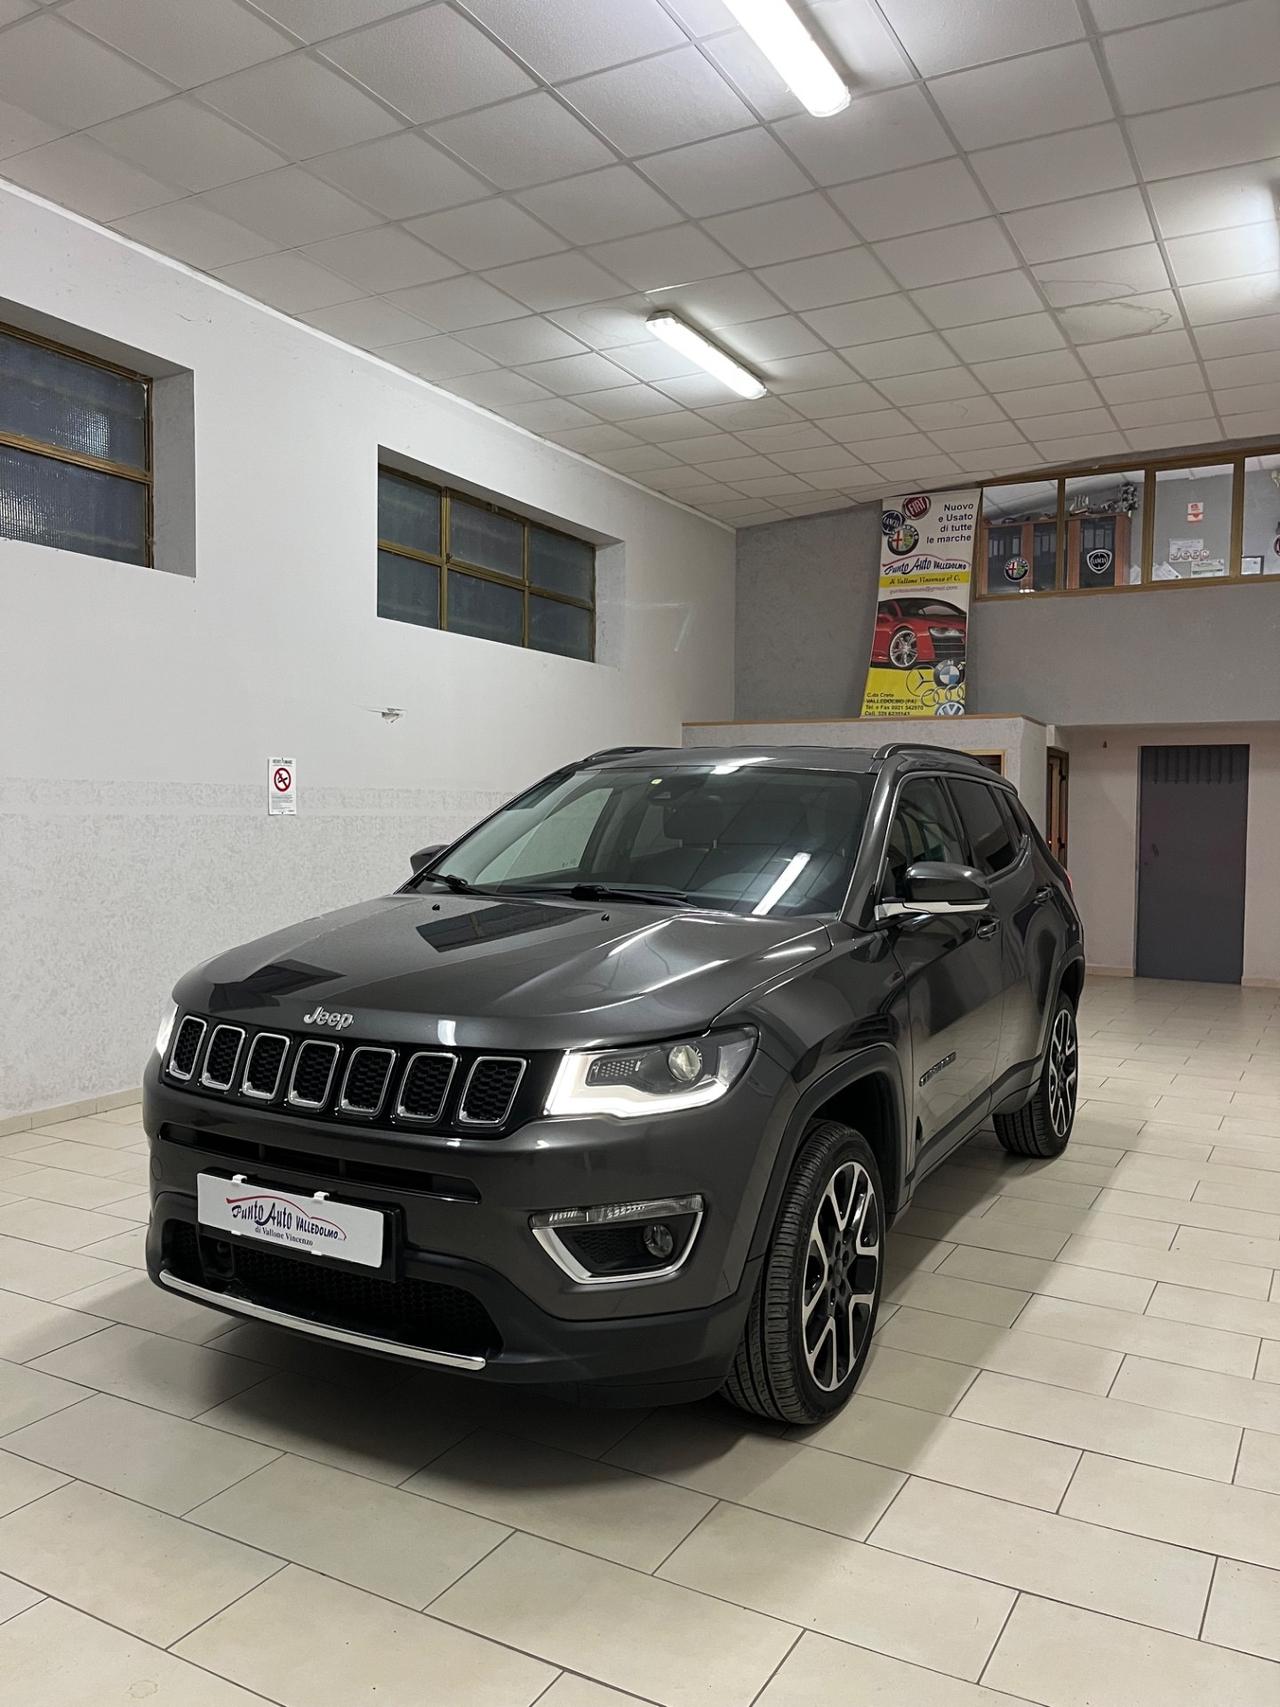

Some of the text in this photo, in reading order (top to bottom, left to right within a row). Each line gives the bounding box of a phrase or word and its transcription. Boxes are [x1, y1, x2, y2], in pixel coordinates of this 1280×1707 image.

[908, 497, 926, 515] FIAT
[944, 503, 974, 512] Nuovo
[946, 513, 973, 522] Usato
[940, 523, 972, 533] di tutte
[926, 534, 972, 544] le marche
[1171, 548, 1209, 562] Jeep
[884, 557, 967, 575] Punto Auto VALLEDOLMO
[303, 1006, 353, 1031] Jeep
[231, 1201, 339, 1240] Punto Auto VALLEDOLMO
[255, 1225, 314, 1247] di Vallone Vincenzo
